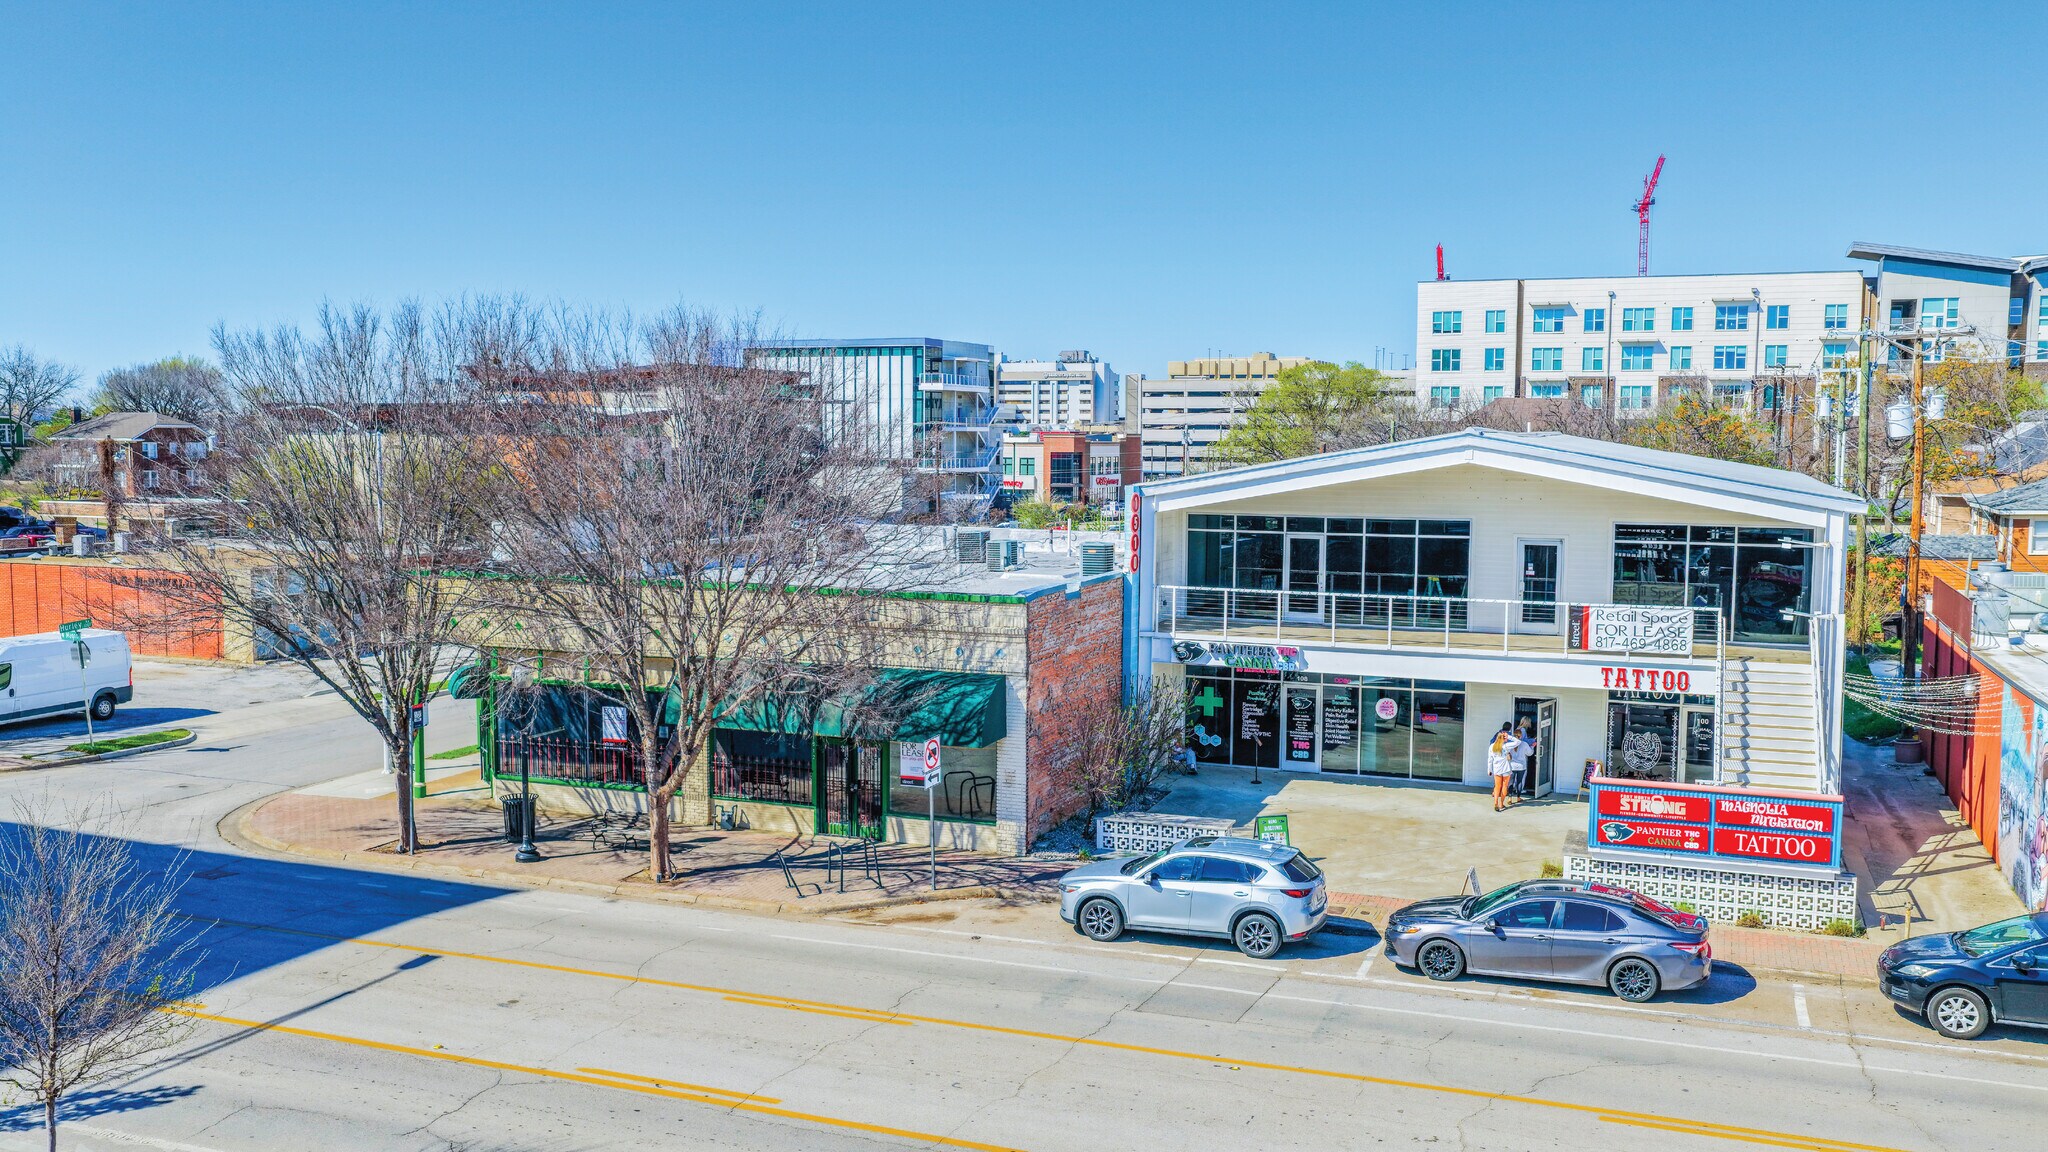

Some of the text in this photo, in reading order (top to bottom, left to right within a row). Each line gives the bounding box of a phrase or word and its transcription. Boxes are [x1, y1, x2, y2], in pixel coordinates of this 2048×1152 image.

[1596, 609, 1688, 627] Retail Space
[60, 621, 82, 632] Hurley
[1596, 624, 1687, 639] FOR LEASE
[1208, 642, 1298, 657] PANTHER THC
[1595, 637, 1687, 651] 817-469-4868
[1223, 656, 1296, 671] CANNA CBD
[1601, 667, 1691, 692] TATTOO
[902, 742, 917, 750] FOR
[1292, 740, 1310, 749] THC
[1292, 750, 1309, 758] CBD
[1636, 825, 1700, 838] PANTHER THC
[1647, 836, 1700, 850] CANNA CBD
[1734, 833, 1817, 858] TATTOO
